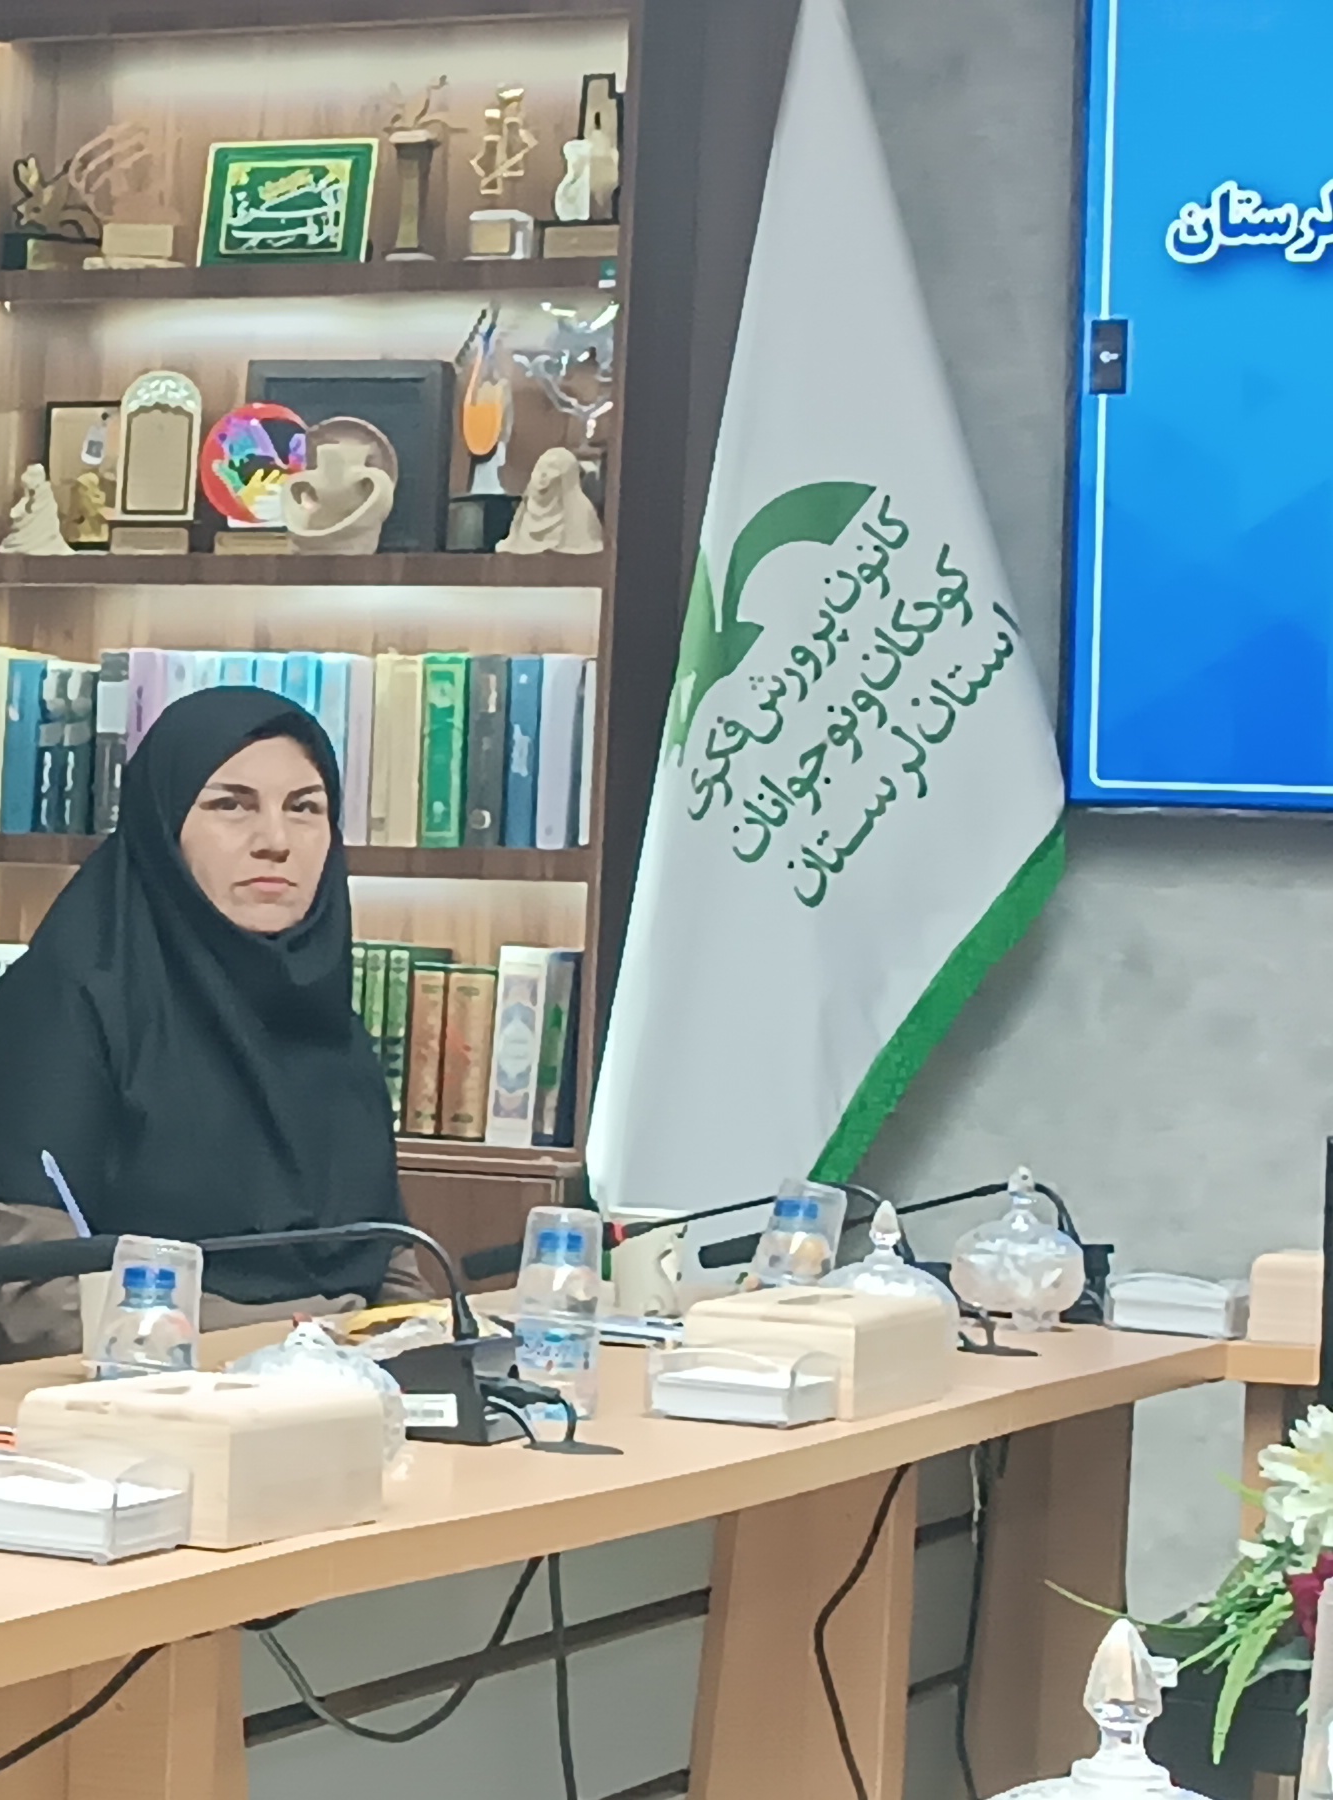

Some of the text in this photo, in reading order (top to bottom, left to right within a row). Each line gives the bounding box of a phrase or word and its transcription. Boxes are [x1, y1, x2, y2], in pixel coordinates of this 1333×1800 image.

[688, 495, 909, 820] کانون پرورش فکری
[861, 544, 973, 691] کودکان
[732, 705, 863, 863] نوجوانان
[788, 602, 1021, 908] استان لرستان
